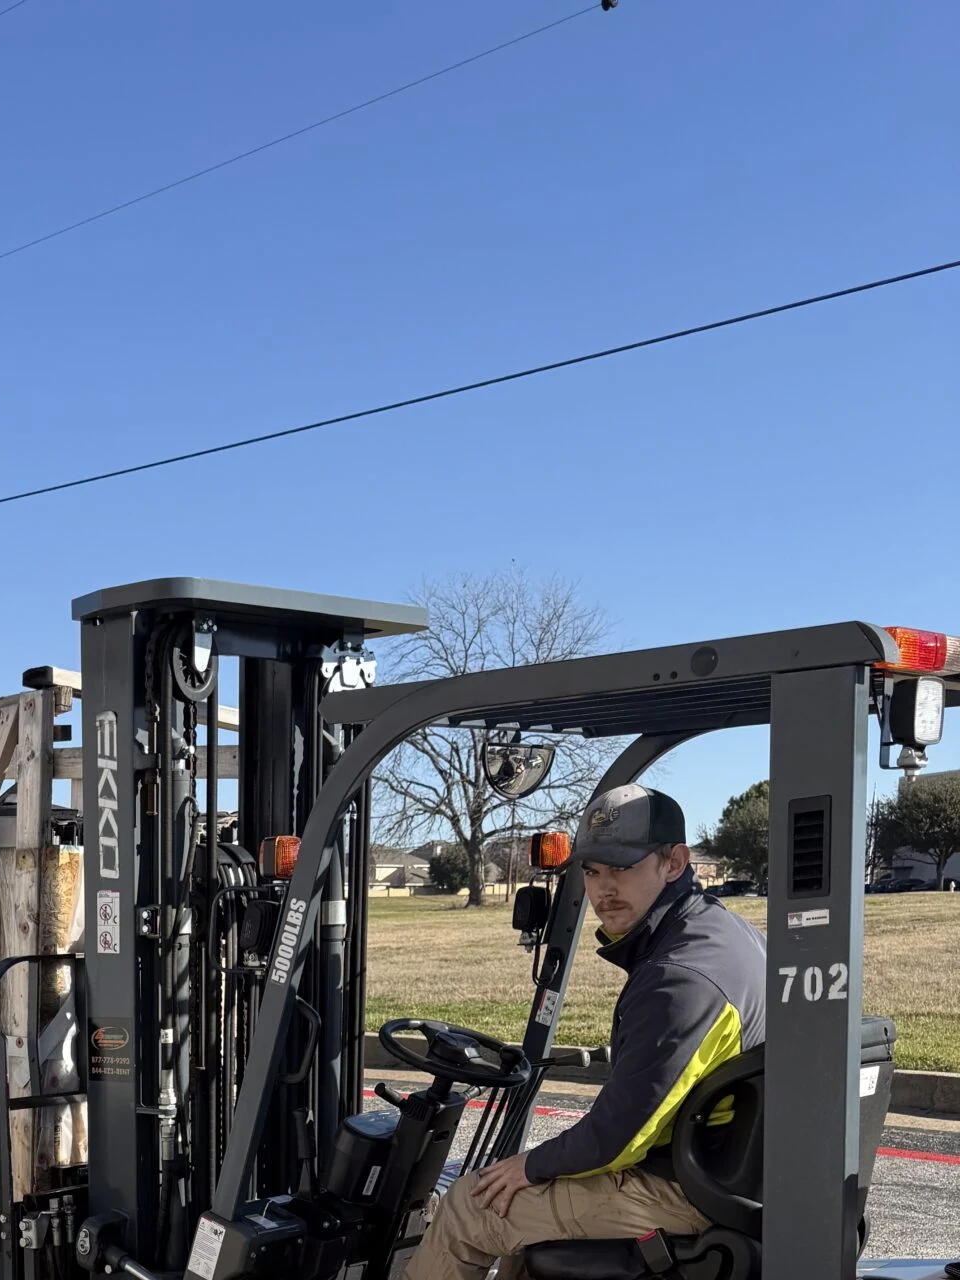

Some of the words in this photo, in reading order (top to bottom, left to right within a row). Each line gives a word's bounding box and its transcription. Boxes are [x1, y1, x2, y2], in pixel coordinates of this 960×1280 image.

[96, 711, 120, 879] EKKO
[271, 898, 307, 984] 5000LBS
[778, 963, 849, 1003] 702
